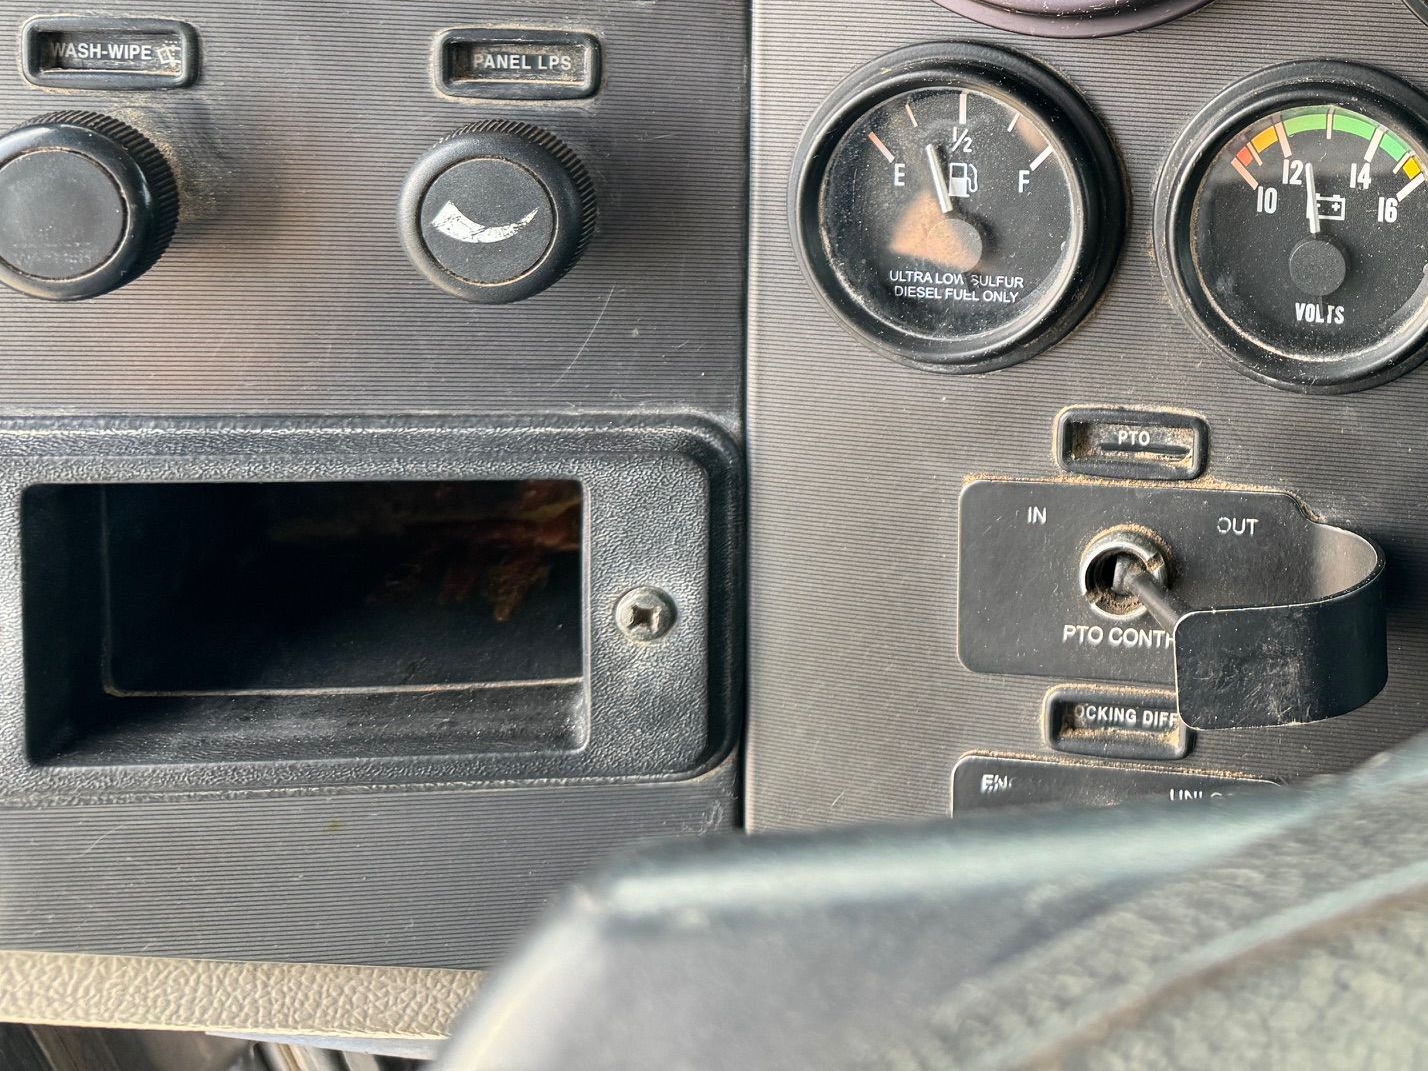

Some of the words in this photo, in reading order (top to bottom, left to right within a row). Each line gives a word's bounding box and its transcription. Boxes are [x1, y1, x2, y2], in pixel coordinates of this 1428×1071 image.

[51, 42, 152, 60] WASH-WIPE
[473, 54, 532, 70] PANEL
[538, 54, 572, 70] LPS
[893, 163, 905, 186] E
[1018, 169, 1030, 193] F
[1282, 159, 1302, 185] 12
[1350, 163, 1371, 189] 14
[1256, 187, 1278, 213] 10
[1377, 197, 1398, 223] 16
[889, 270, 933, 284] ULTRA
[970, 274, 1024, 288] SULFUR
[894, 285, 942, 299] DIESEL
[945, 287, 980, 301] FUEL
[982, 290, 1020, 303] ONLY
[1295, 302, 1345, 324] VOLTS
[1117, 430, 1151, 446] PTO
[1026, 506, 1047, 525] IN
[1216, 517, 1259, 535] OUT
[1062, 624, 1104, 646] PTO
